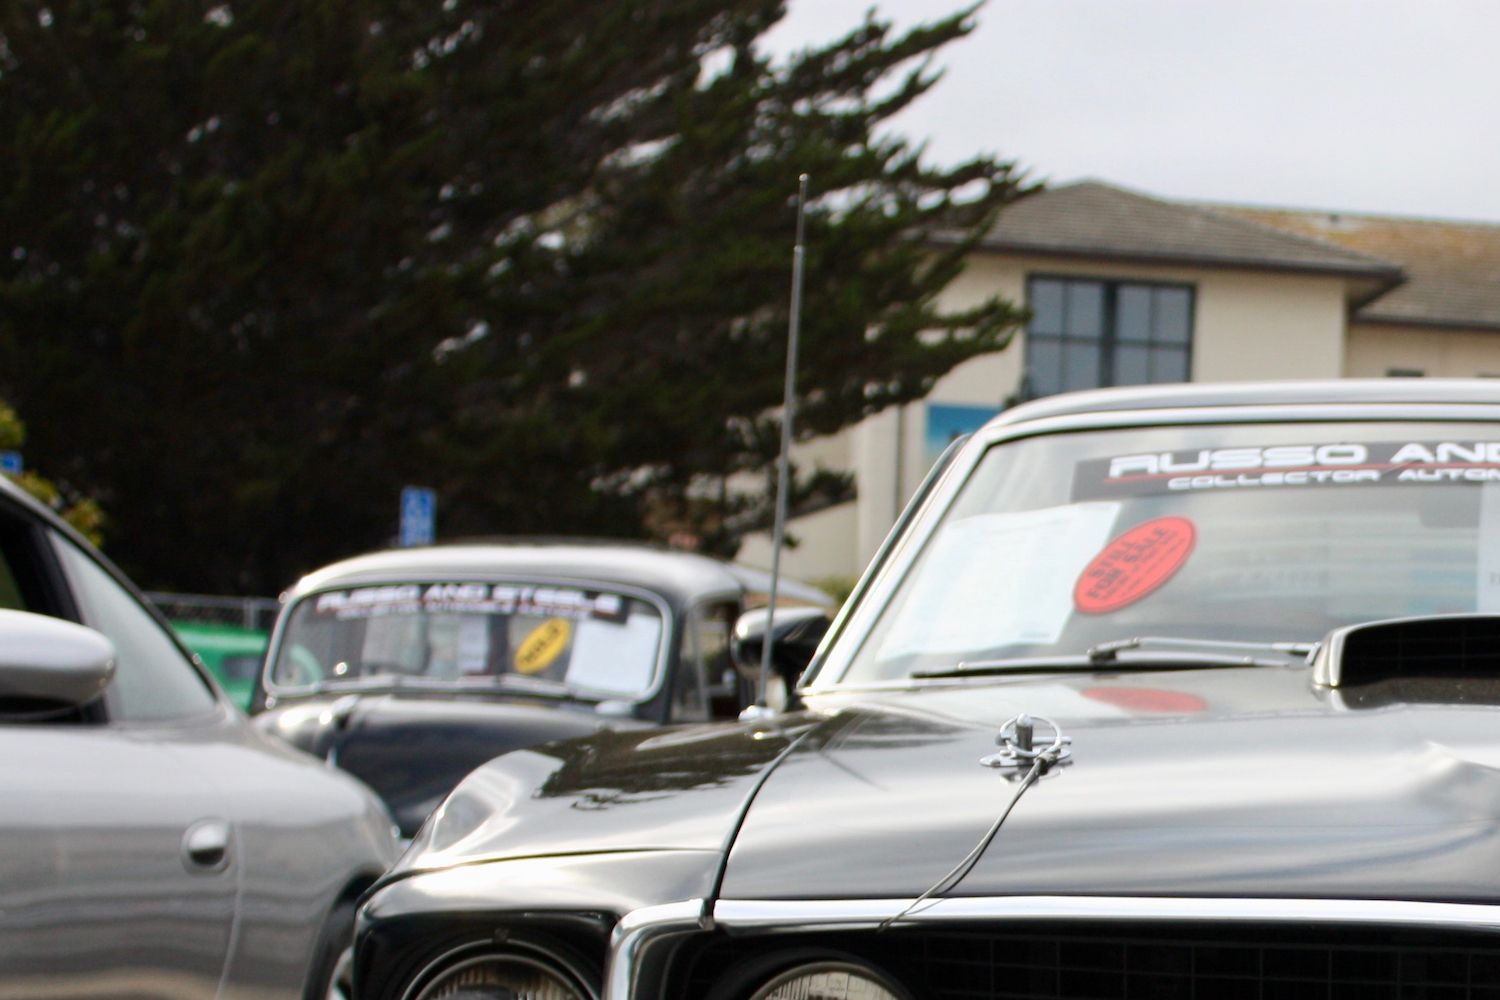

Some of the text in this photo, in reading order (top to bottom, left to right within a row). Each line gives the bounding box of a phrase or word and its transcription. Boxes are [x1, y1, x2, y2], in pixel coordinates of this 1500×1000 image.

[1109, 444, 1368, 478] RUSSO
[1168, 469, 1381, 490] COLLECTOR
[1086, 567, 1124, 598] FOR
[1123, 527, 1169, 564] SALE
